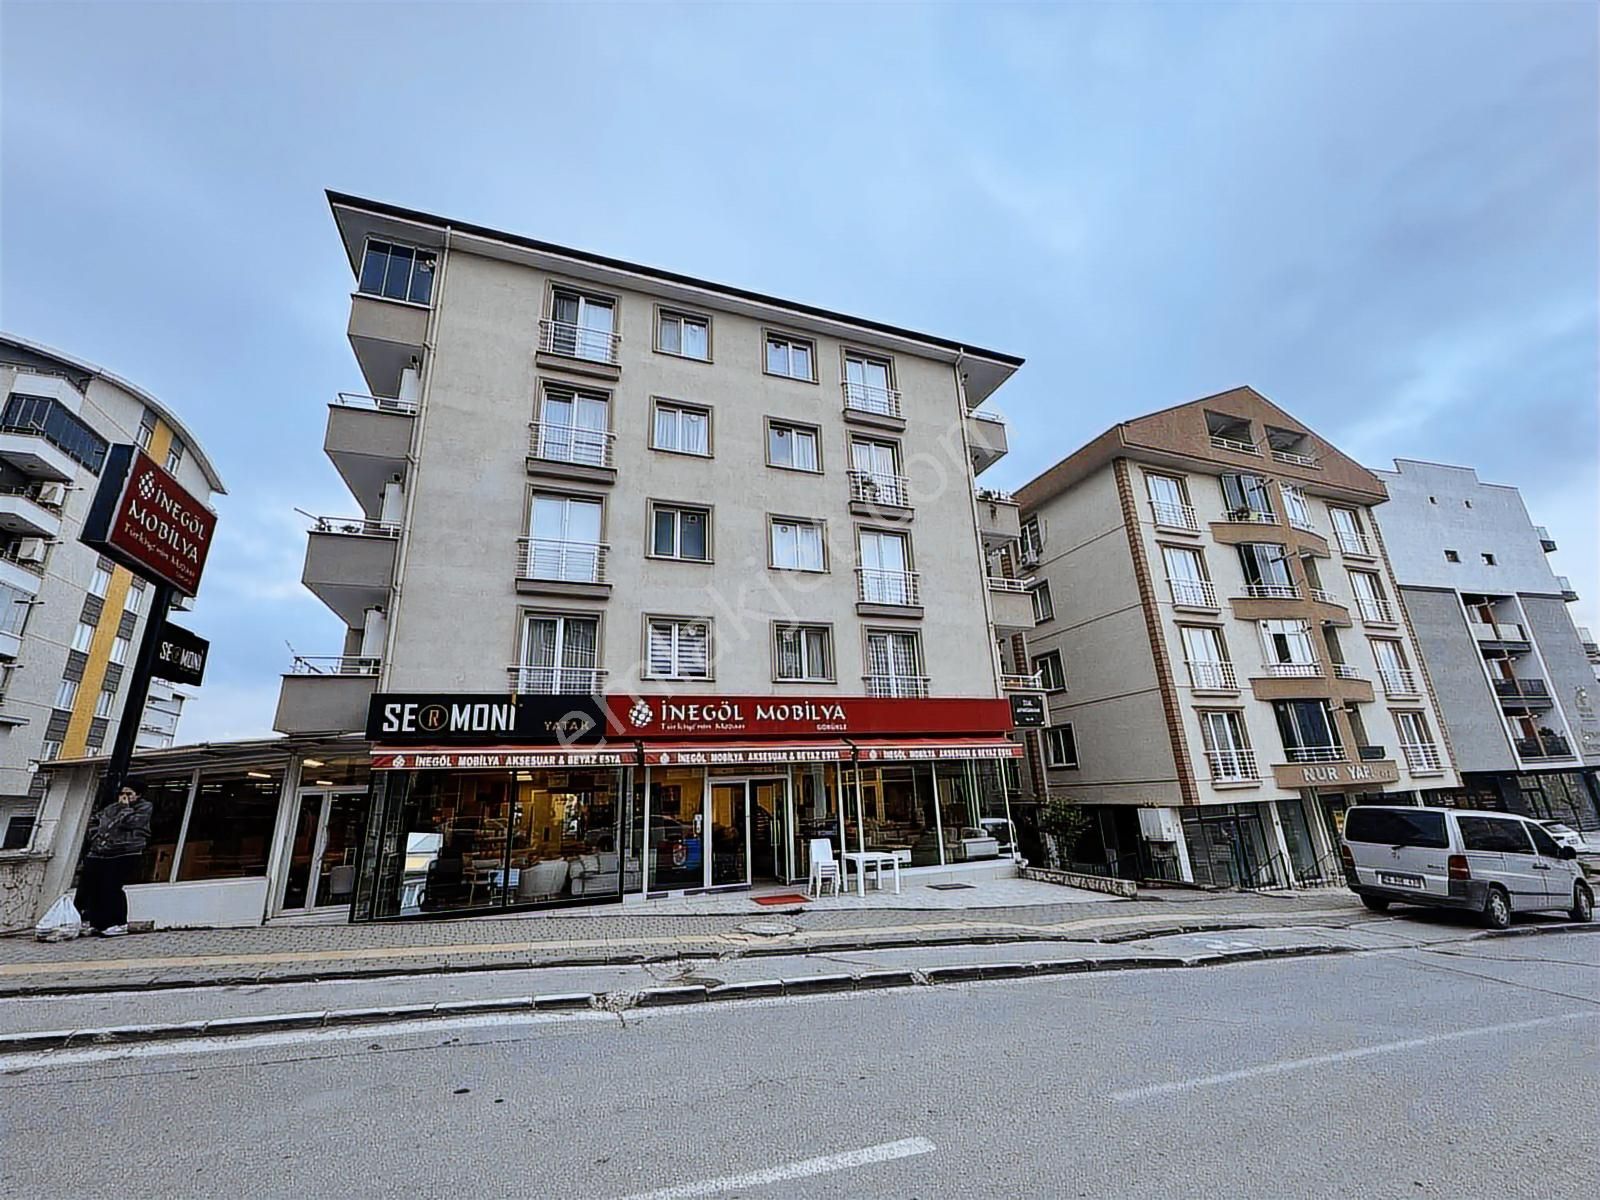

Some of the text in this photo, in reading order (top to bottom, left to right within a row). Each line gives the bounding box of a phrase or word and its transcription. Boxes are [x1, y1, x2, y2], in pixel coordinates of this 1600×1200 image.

[155, 484, 204, 540] İNEGÖL
[128, 499, 198, 563] MOBİLYA
[661, 700, 846, 721] İNEGÖL MOBİLYA
[415, 754, 453, 767] İNEGÖL
[457, 754, 499, 766] MOBİLYA
[505, 755, 556, 766] AKSESUAR
[558, 755, 565, 765] &
[677, 752, 707, 763] İNEGÖL
[747, 752, 788, 762] AKSESUAR
[1302, 767, 1339, 782] NUR
